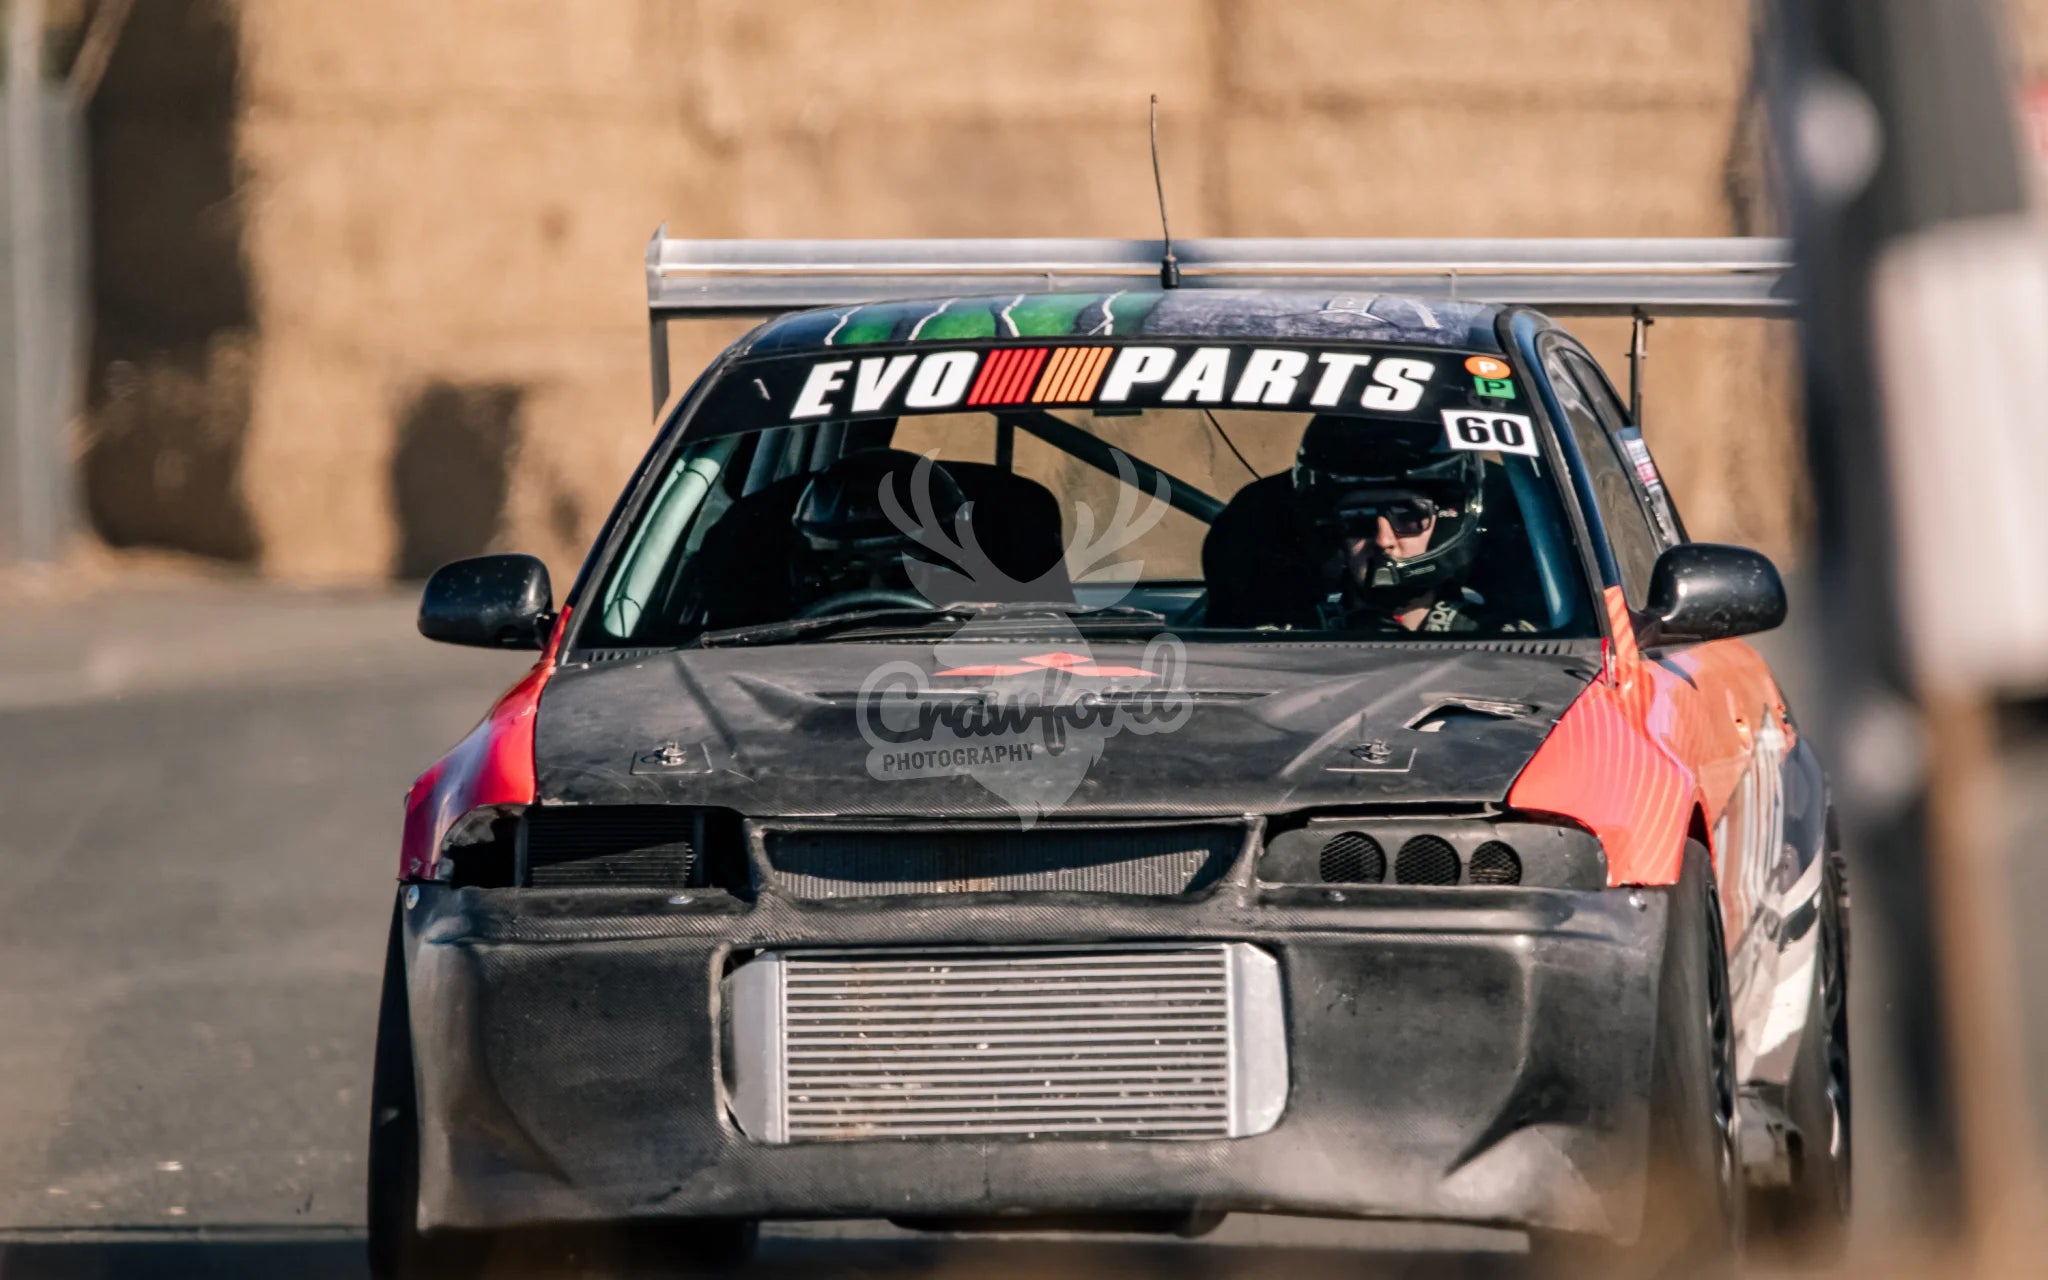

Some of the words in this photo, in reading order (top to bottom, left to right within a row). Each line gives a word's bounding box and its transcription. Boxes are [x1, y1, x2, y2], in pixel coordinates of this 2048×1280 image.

[1478, 361, 1497, 374] P
[790, 351, 979, 419] EVO
[1099, 346, 1435, 412] PARTS
[1483, 380, 1506, 392] P
[1456, 416, 1524, 447] 60
